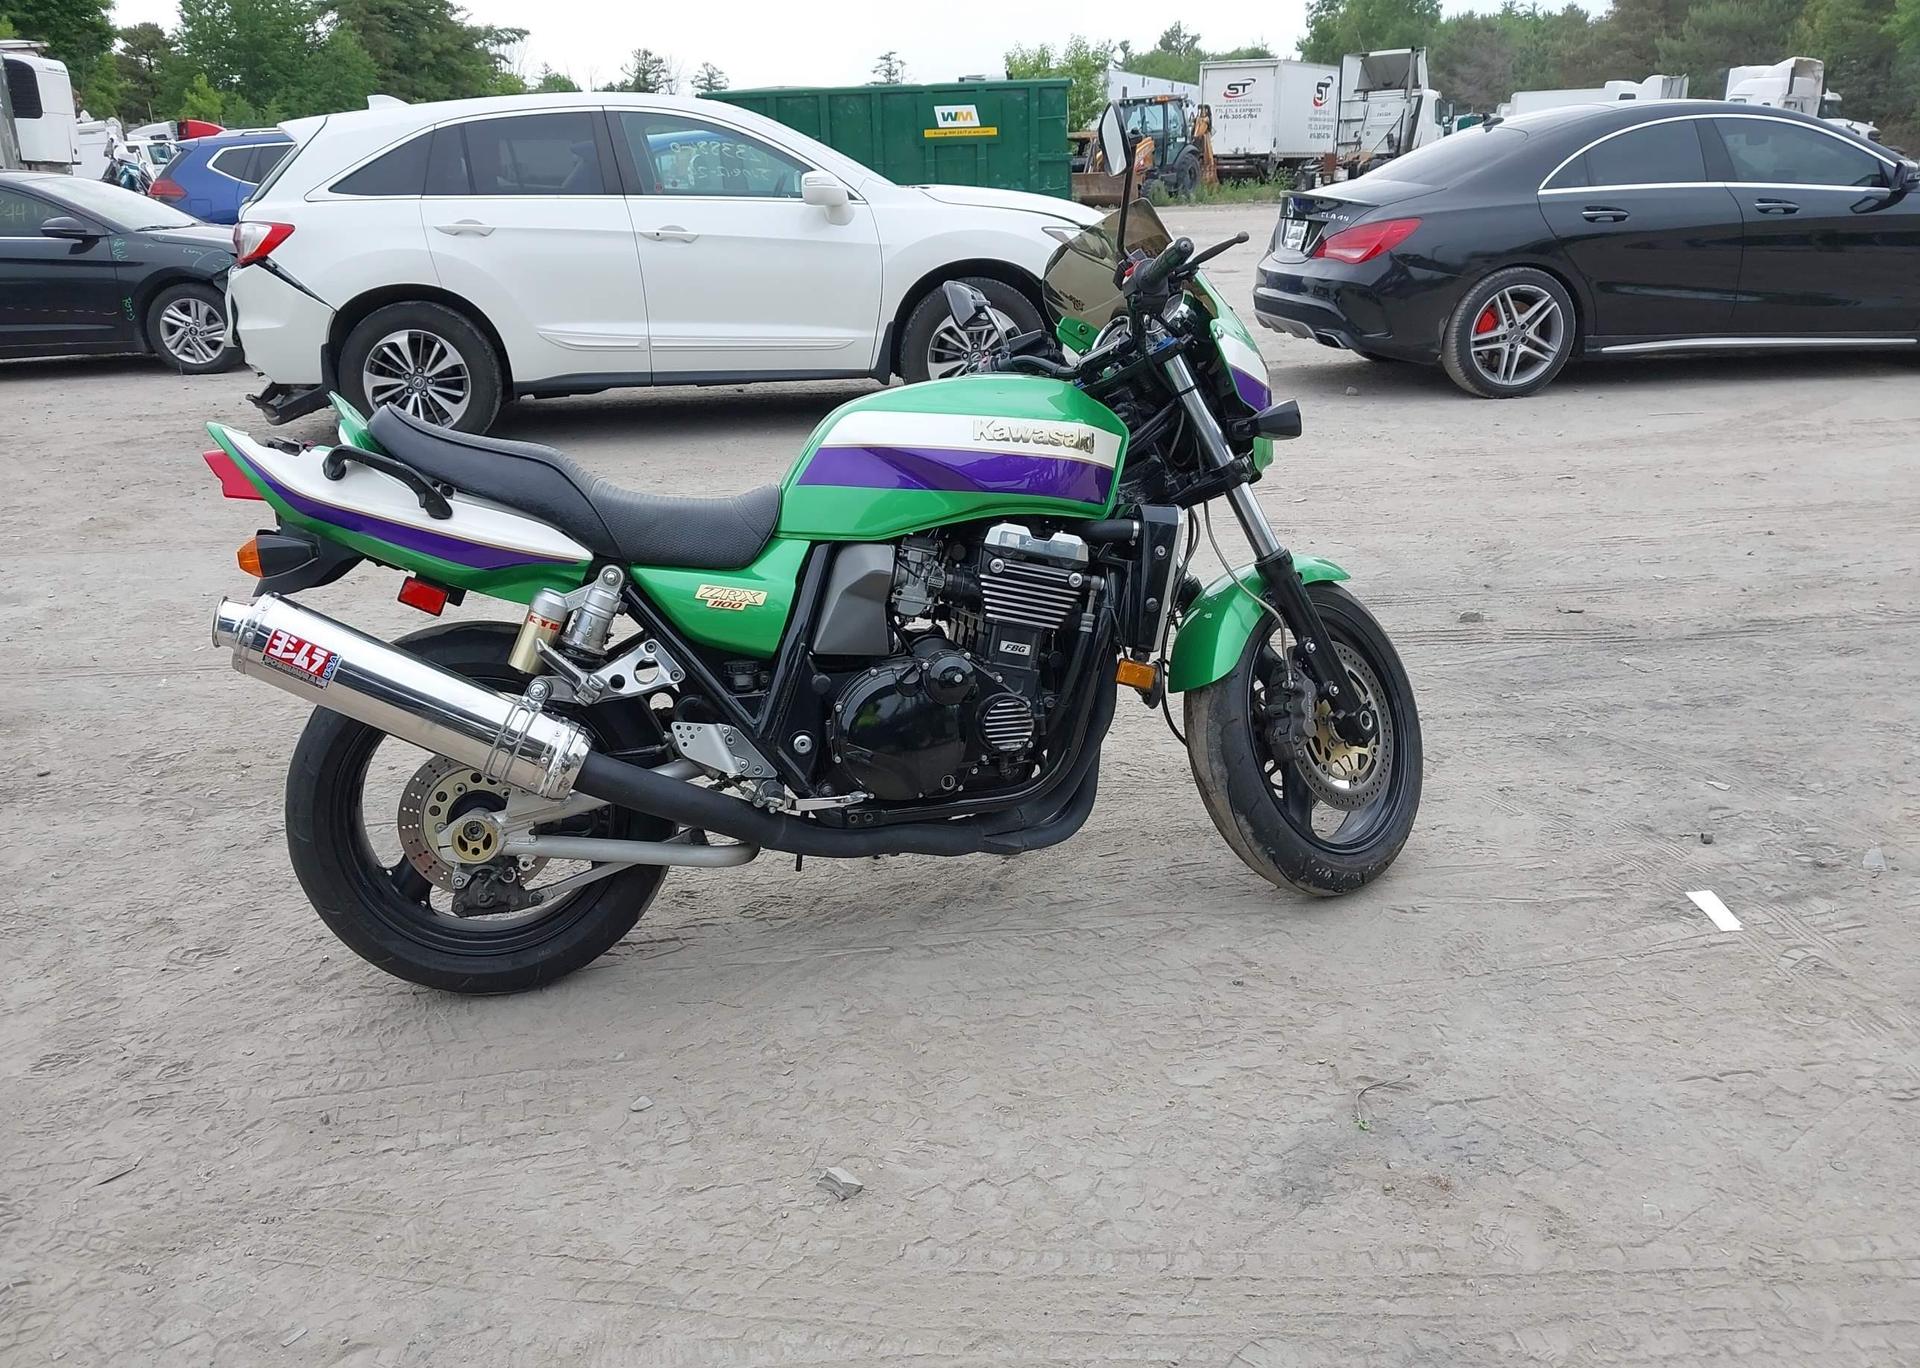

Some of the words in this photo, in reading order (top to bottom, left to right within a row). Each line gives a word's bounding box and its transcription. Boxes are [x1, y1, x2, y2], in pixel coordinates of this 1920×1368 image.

[1227, 83, 1252, 94] ST
[941, 112, 974, 122] WM
[973, 419, 1095, 455] Kawasaki
[700, 586, 762, 604] ZRX
[711, 600, 743, 609] 1100
[529, 615, 559, 631] KYB
[268, 630, 328, 673] ヨシムラ
[1005, 644, 1027, 653] FBG
[322, 655, 338, 680] USA
